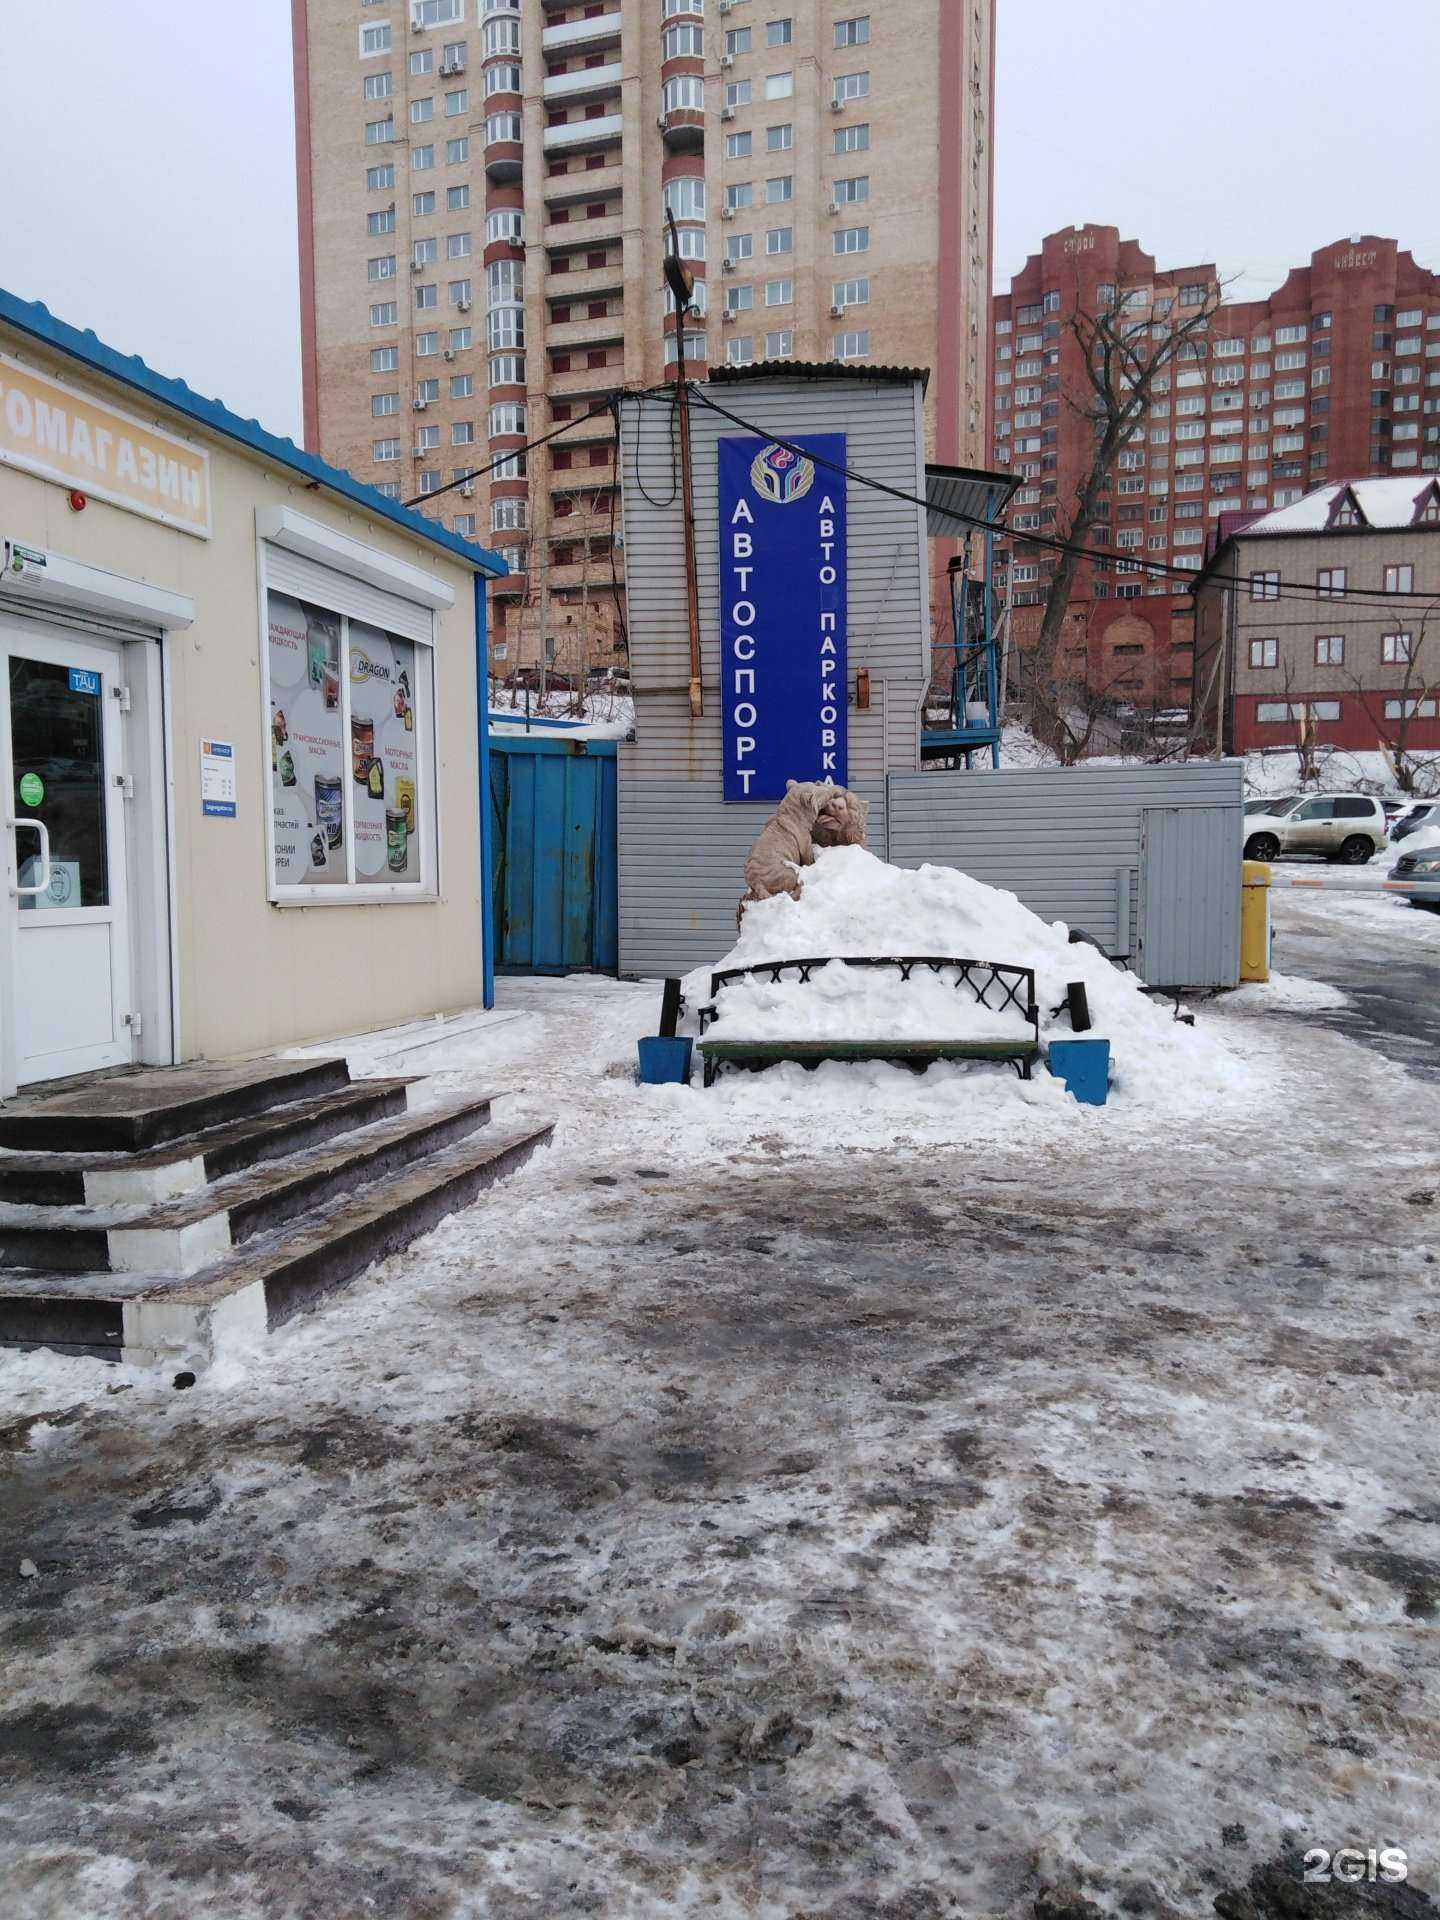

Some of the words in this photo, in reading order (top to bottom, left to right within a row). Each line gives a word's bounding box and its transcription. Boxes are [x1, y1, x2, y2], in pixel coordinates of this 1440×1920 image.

[818, 495, 837, 585] АВТО
[358, 659, 389, 679] DRAGON
[731, 498, 757, 795] АВТОСПОРТ
